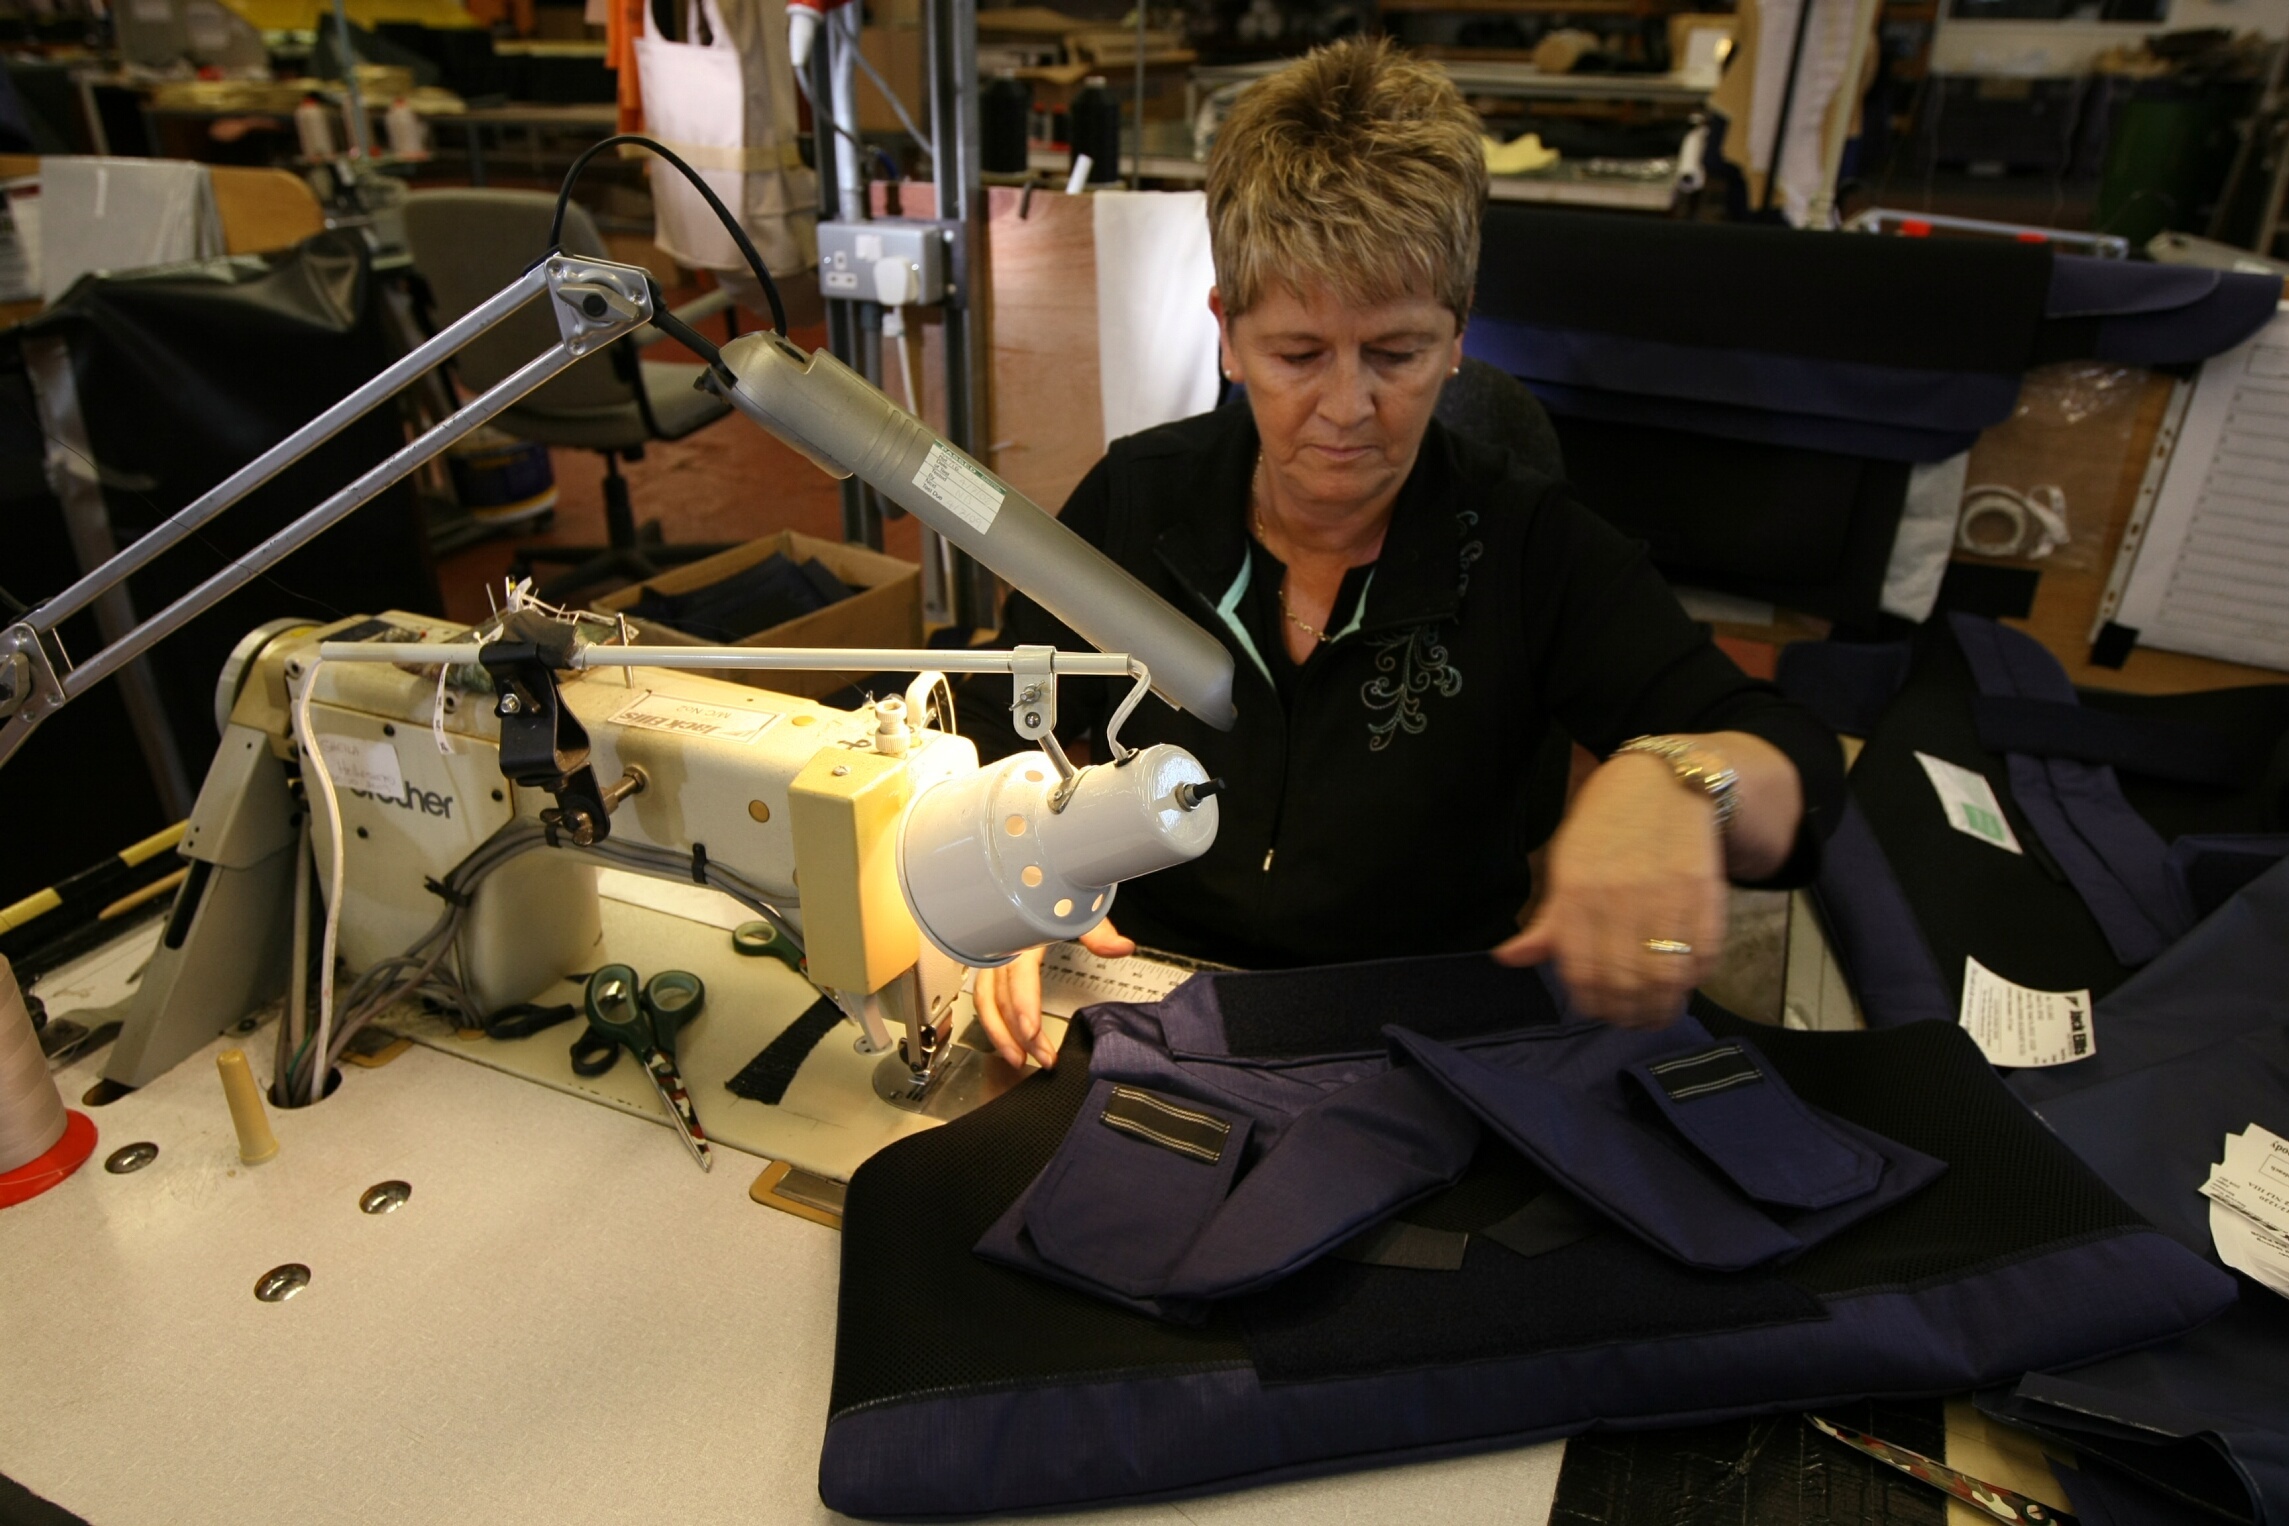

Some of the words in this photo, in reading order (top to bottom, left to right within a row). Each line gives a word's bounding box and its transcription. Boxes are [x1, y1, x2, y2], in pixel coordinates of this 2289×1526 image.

[940, 446, 976, 473] PASSED
[921, 483, 932, 493] Test
[932, 490, 943, 500] Due
[620, 712, 669, 726] Ellis
[666, 719, 722, 734] Jack
[2070, 1010, 2085, 1032] Jack
[2073, 1033, 2088, 1056] Ellis
[2270, 1140, 2289, 1156] ody
